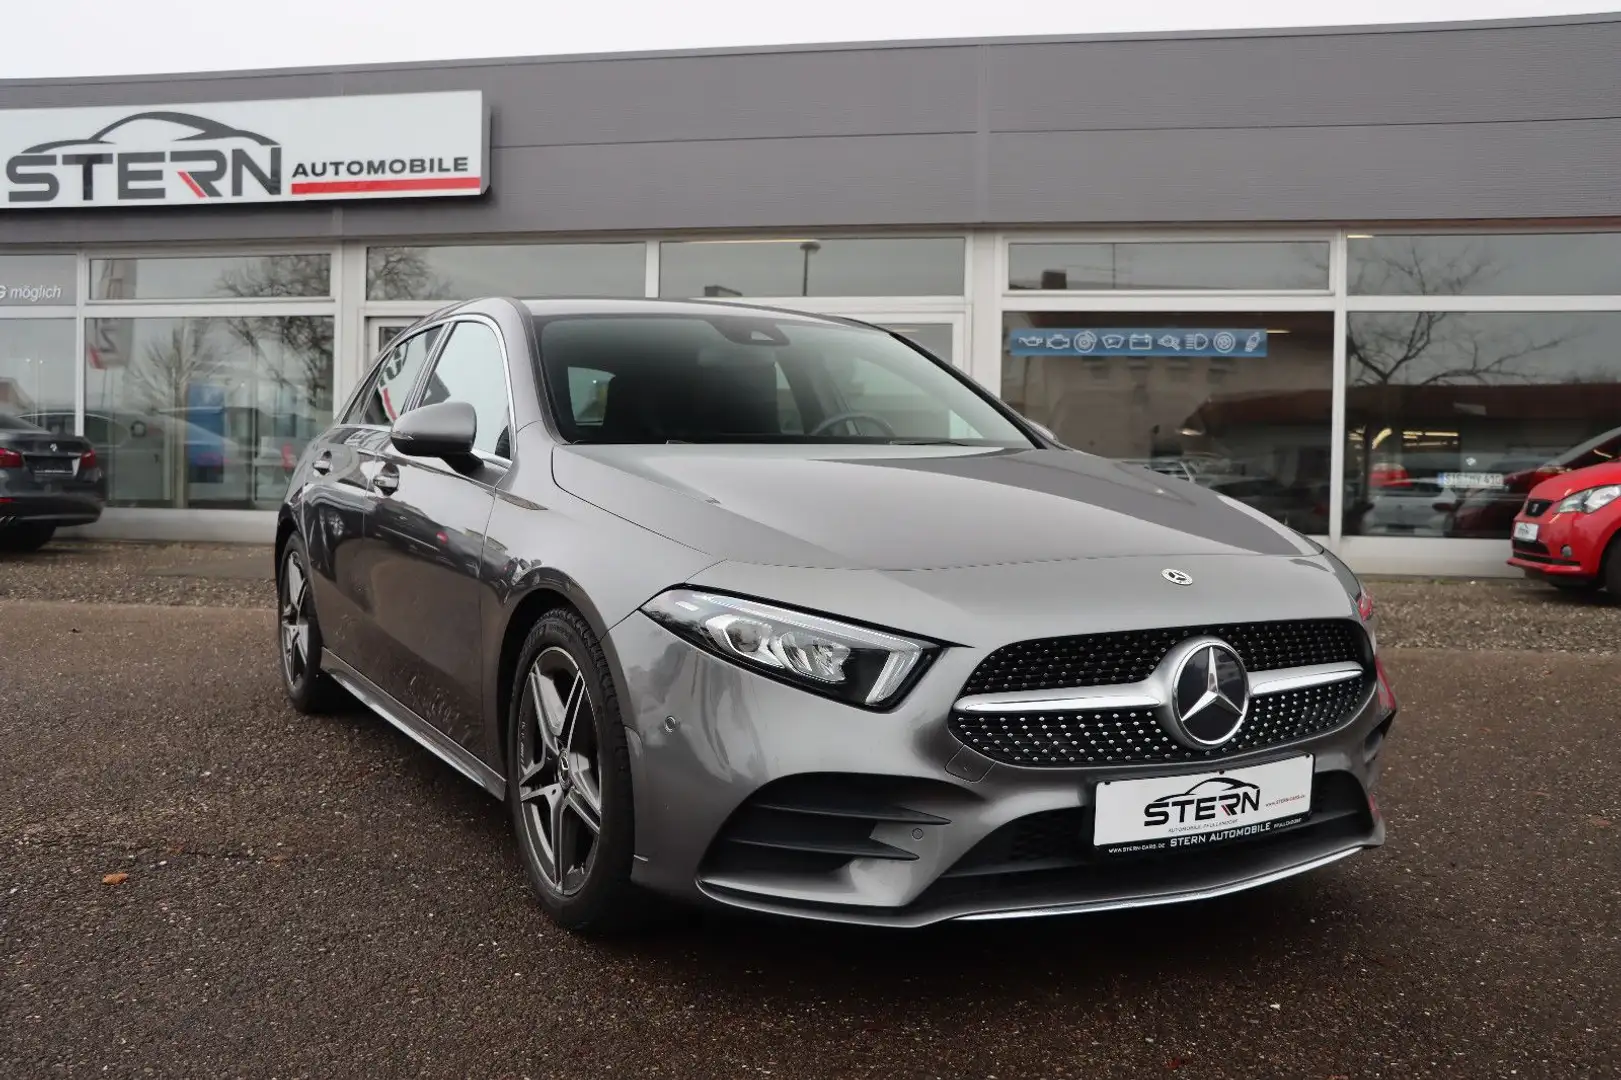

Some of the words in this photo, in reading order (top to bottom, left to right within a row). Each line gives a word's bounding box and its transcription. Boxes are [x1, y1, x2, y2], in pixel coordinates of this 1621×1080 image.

[6, 147, 282, 202] STERN
[292, 157, 468, 178] AUTOMOBILE
[10, 284, 62, 302] möglich
[1144, 789, 1261, 827] STERN
[1170, 834, 1206, 847] STERN
[1208, 822, 1272, 842] AUTOMOBILE
